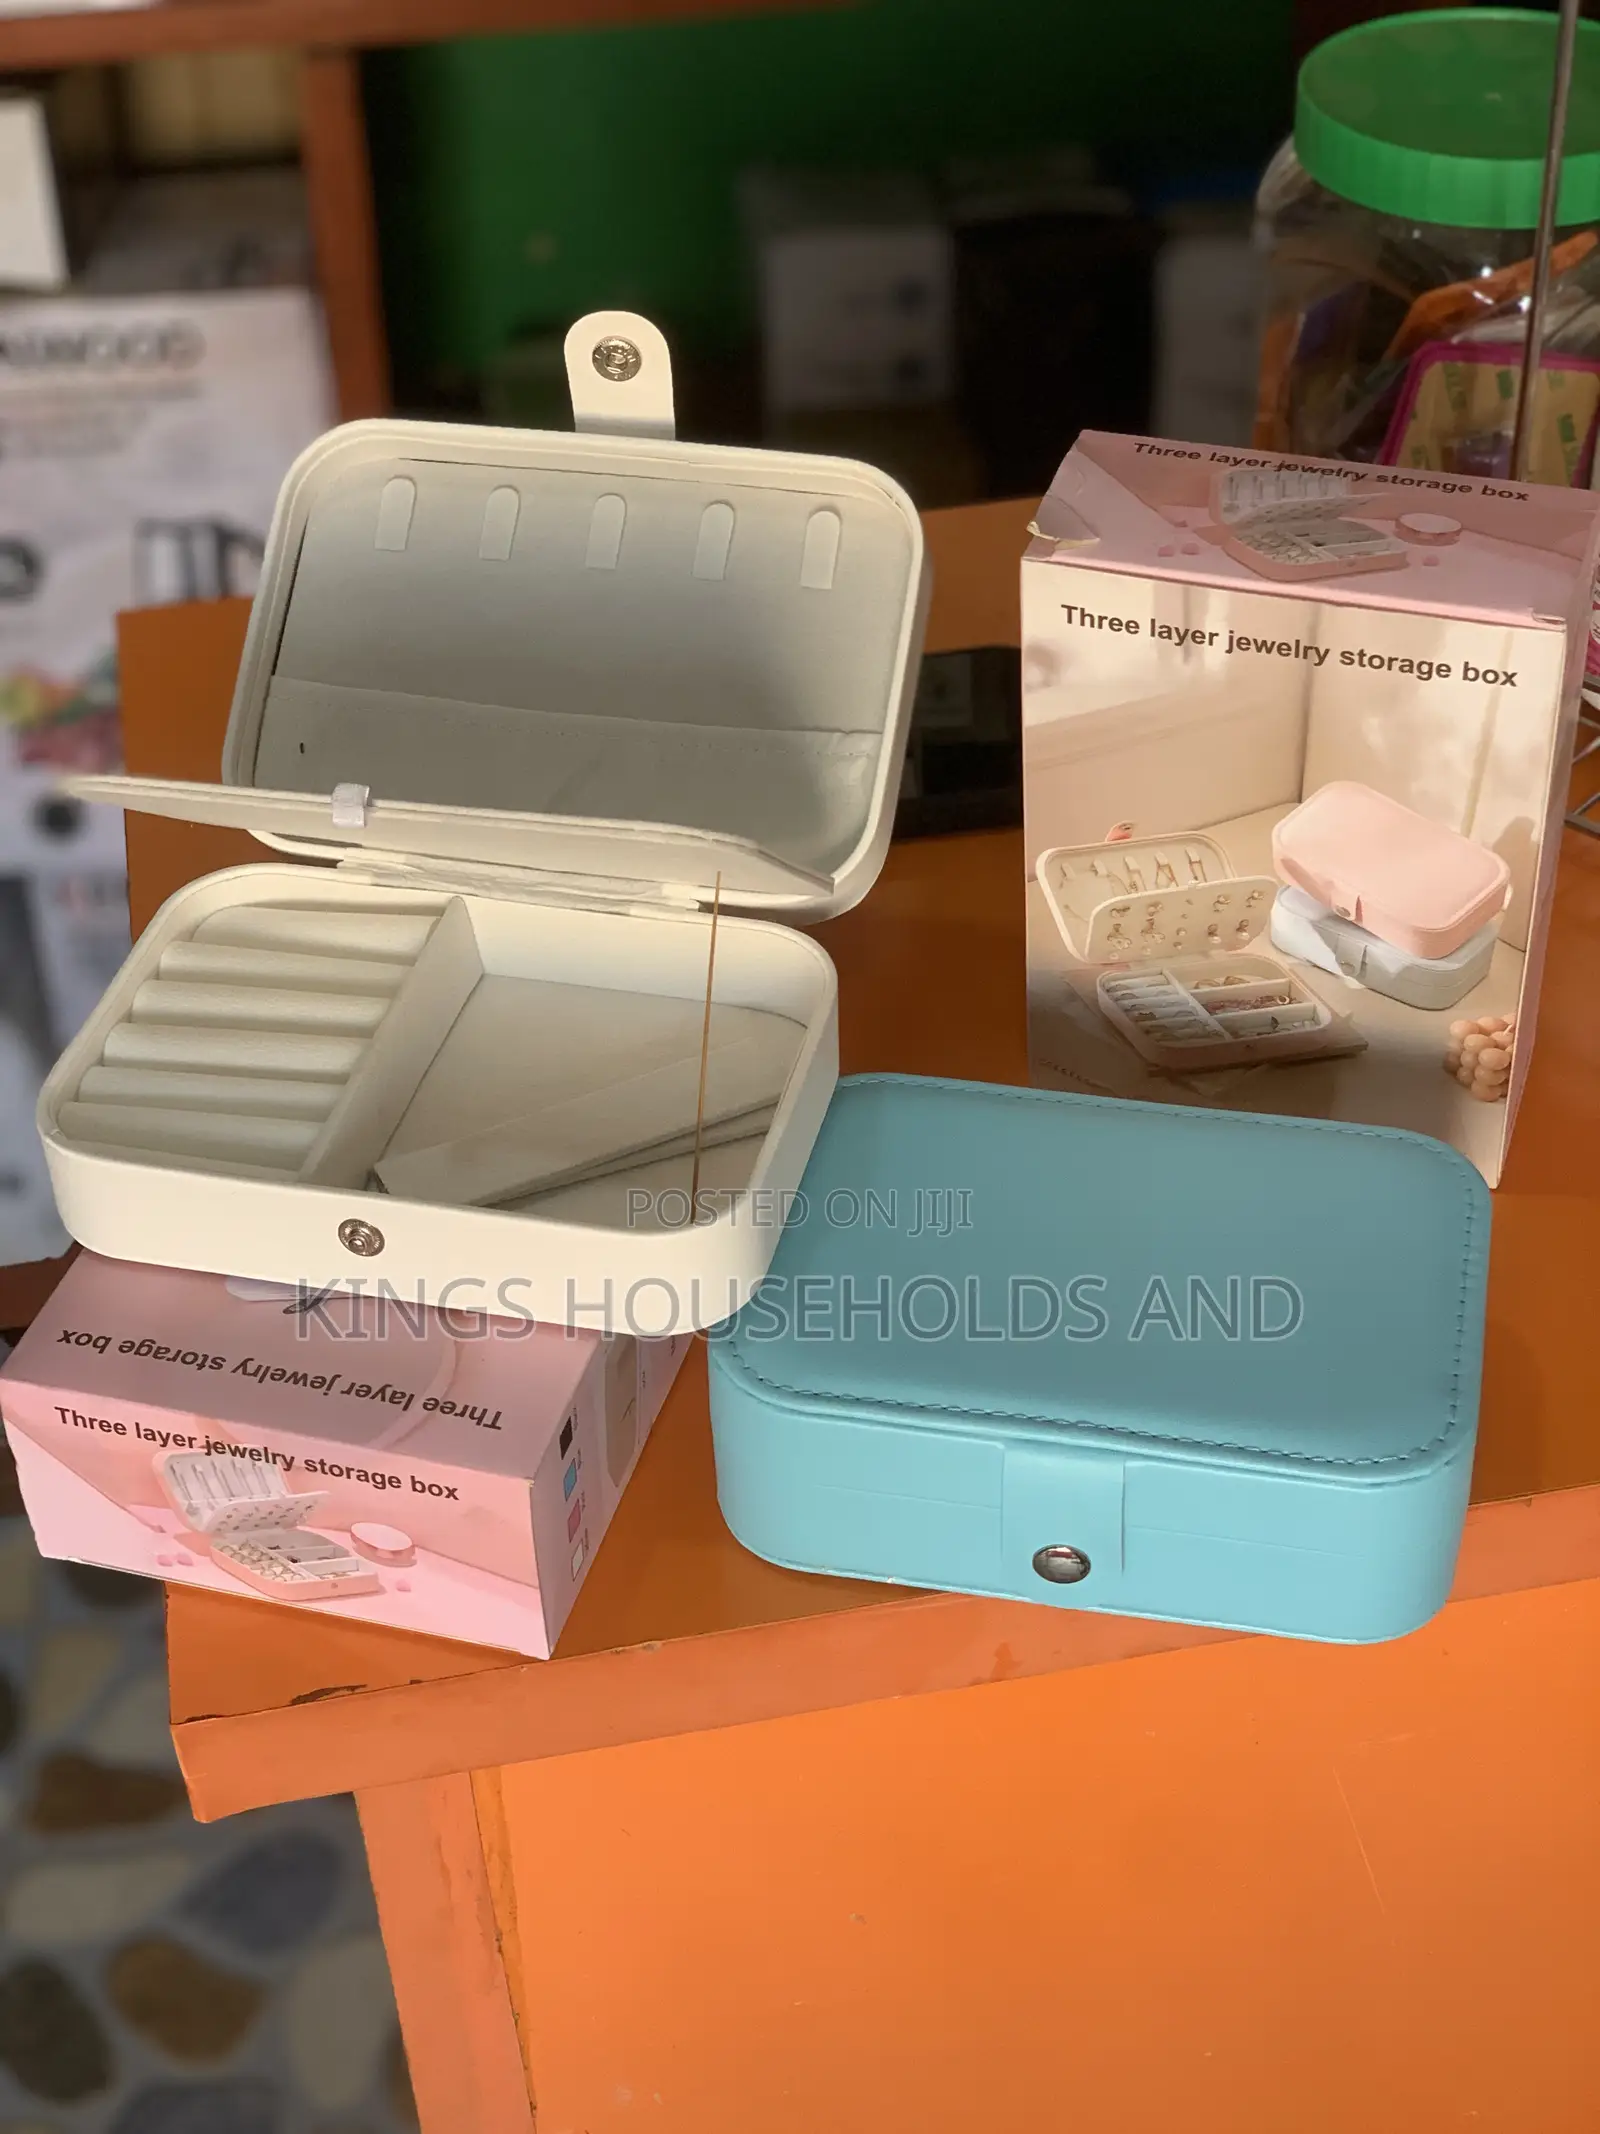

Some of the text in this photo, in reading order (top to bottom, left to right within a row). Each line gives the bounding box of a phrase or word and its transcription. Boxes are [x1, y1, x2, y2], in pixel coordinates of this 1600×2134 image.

[1134, 442, 1530, 501] Three layer jewelry storage box
[1060, 603, 1518, 687] Three layer jewelry storage box
[56, 1329, 503, 1431] Three layer jewelry storage box
[54, 1406, 460, 1500] Three layer jewelry storage box
